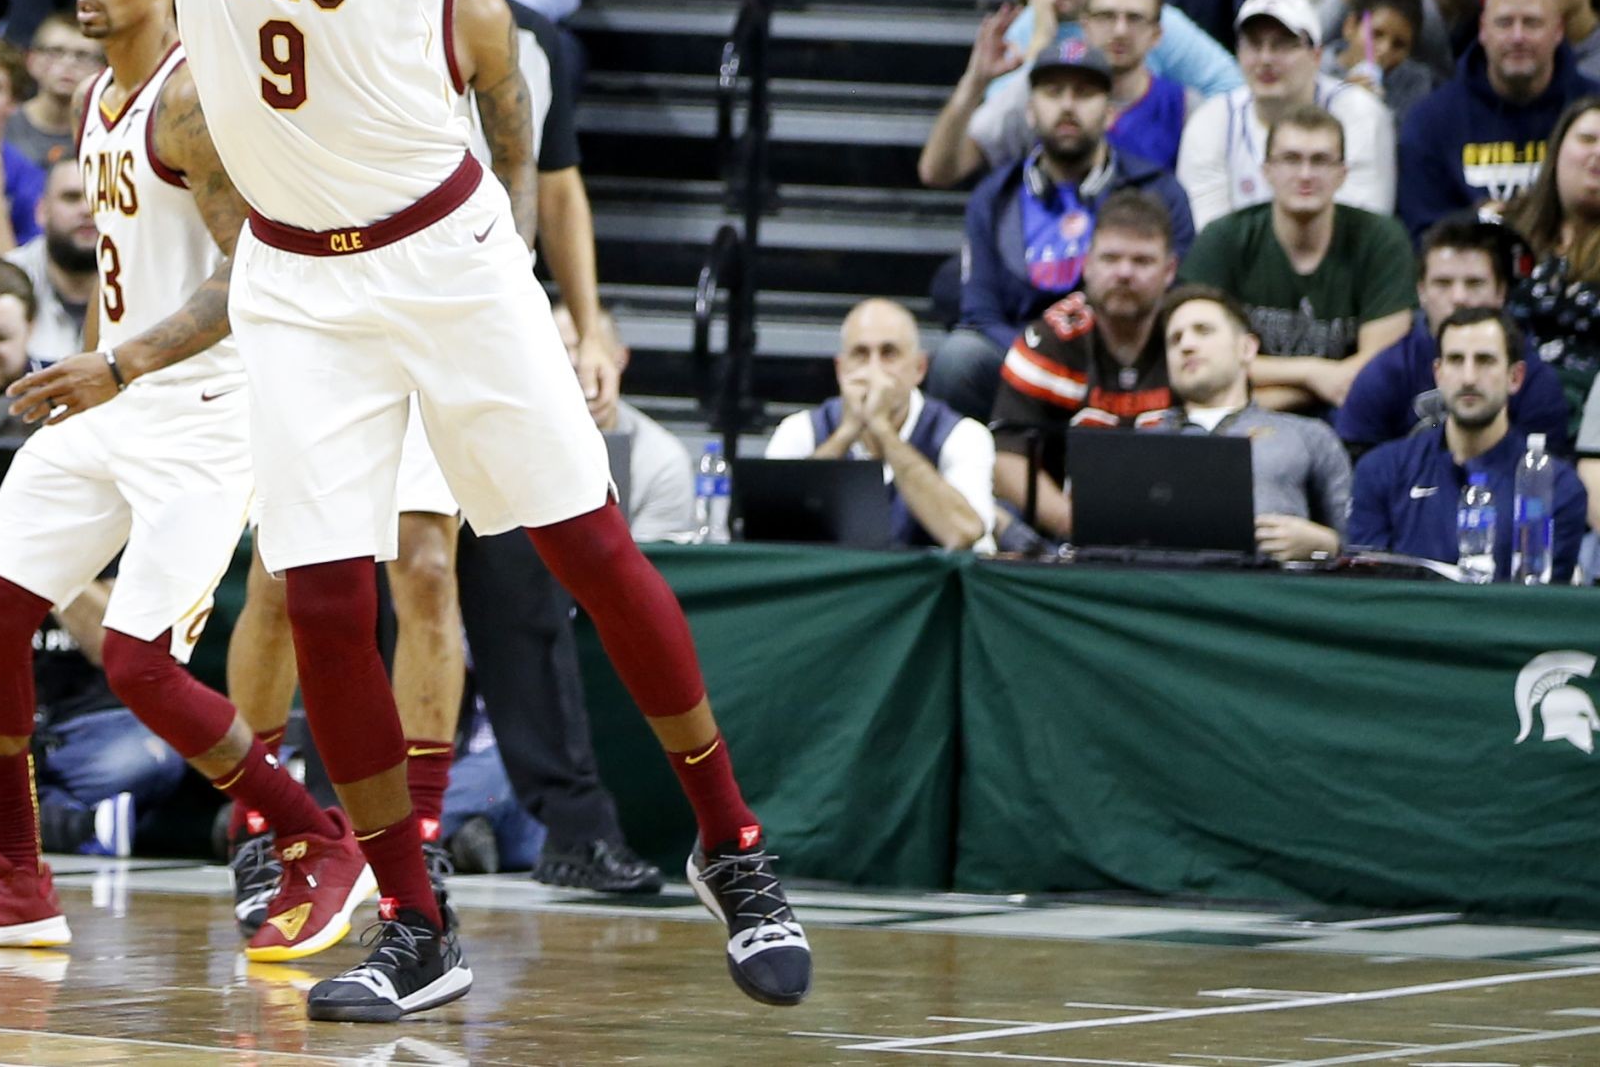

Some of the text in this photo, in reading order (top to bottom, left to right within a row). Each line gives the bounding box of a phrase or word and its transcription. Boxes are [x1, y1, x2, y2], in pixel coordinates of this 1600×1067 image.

[257, 18, 308, 112] 9
[83, 150, 138, 218] CAVS
[100, 234, 125, 323] 3
[330, 231, 364, 252] CLE
